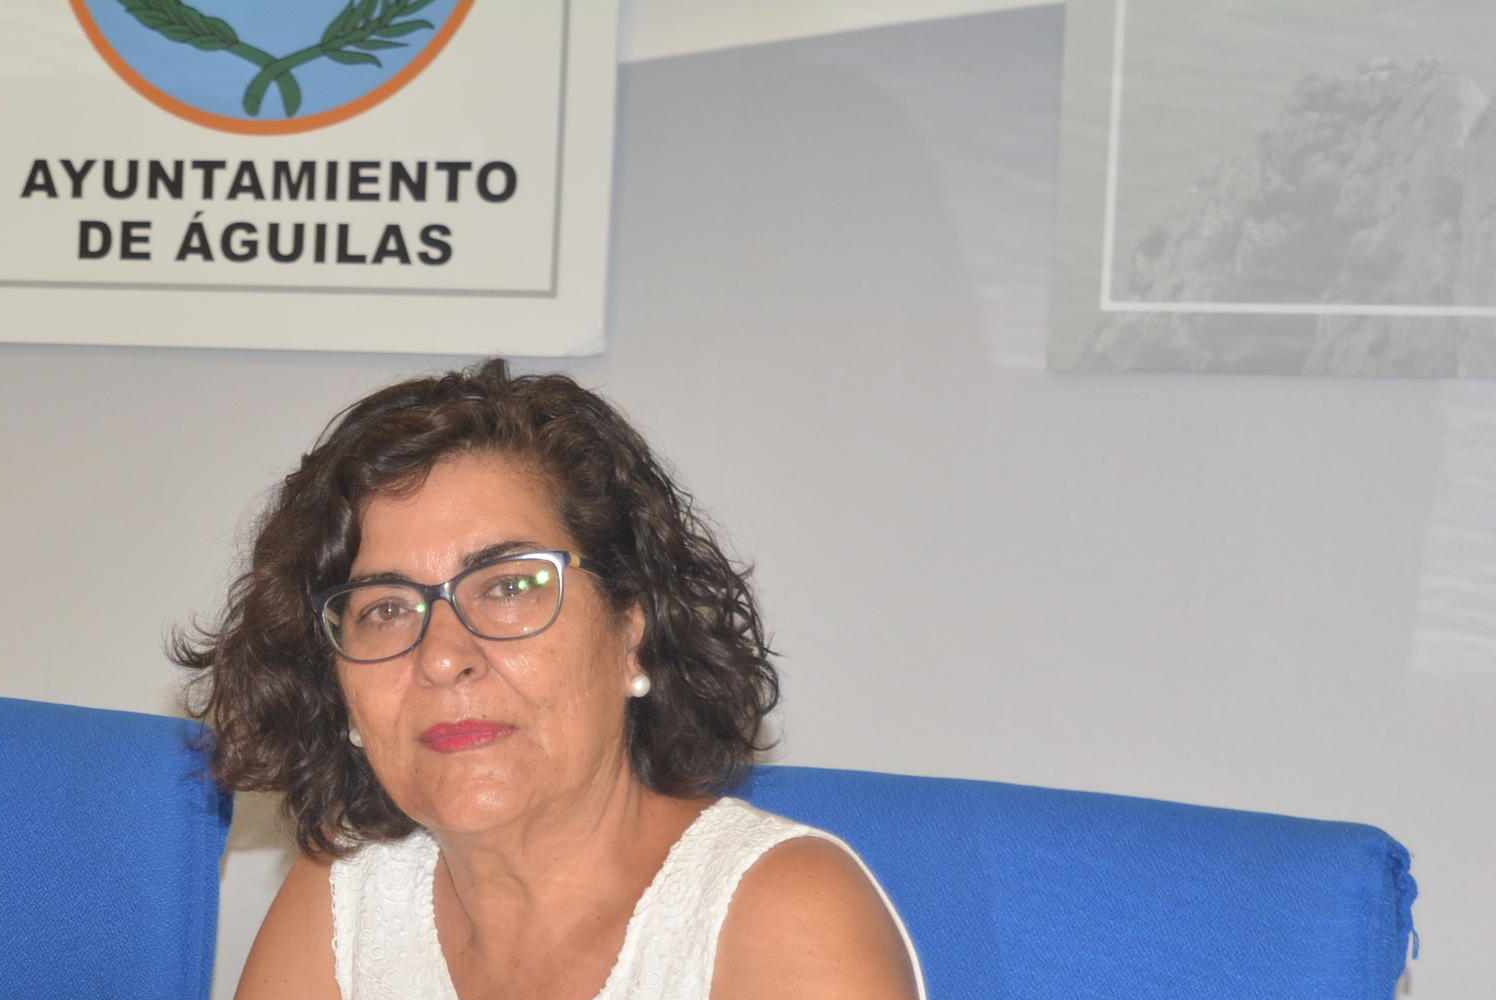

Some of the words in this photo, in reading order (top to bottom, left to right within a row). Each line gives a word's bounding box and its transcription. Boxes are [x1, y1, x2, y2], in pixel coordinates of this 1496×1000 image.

[20, 158, 518, 203] AYUNTAMIENTO
[78, 219, 153, 260] DE
[176, 212, 453, 266] ÁGUILAS
